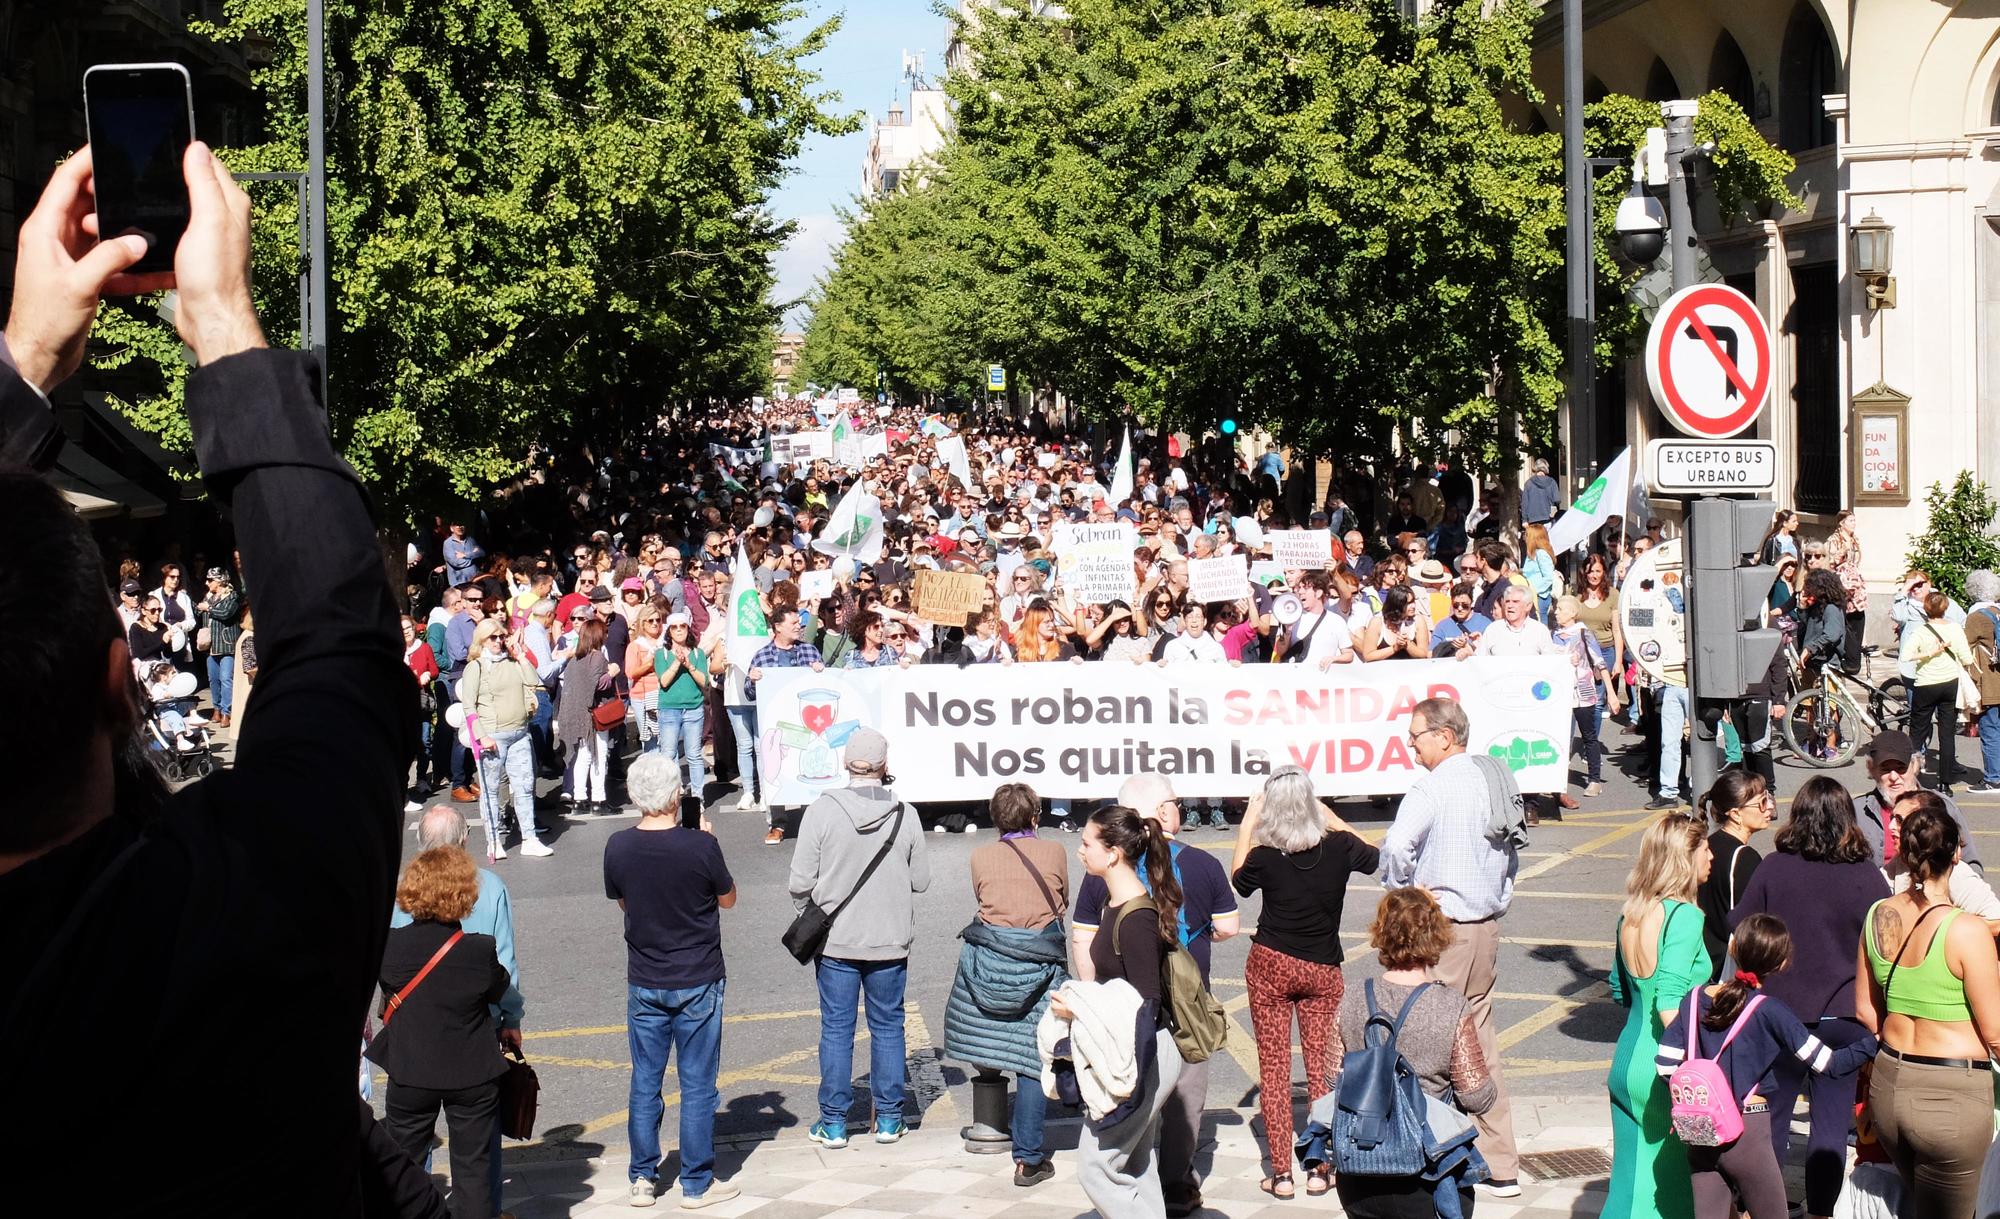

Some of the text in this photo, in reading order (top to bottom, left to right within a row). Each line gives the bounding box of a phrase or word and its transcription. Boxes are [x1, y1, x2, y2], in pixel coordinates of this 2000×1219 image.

[1864, 433, 1887, 442] FUN
[1667, 450, 1763, 464] EXCEPTO BUS
[1864, 448, 1880, 457] DA
[1687, 469, 1747, 482] URBANO
[1288, 532, 1312, 540] LLEVO
[1293, 541, 1320, 550] HORAS
[1079, 563, 1131, 572] CON AGENDAS
[1085, 573, 1125, 582] INFINITAS
[1080, 583, 1132, 592] LA PRIMARIA
[904, 691, 996, 727] Nos
[1011, 687, 1152, 725] roban
[1169, 687, 1208, 725] la
[954, 735, 1415, 783] Nos quitan la VIDA
